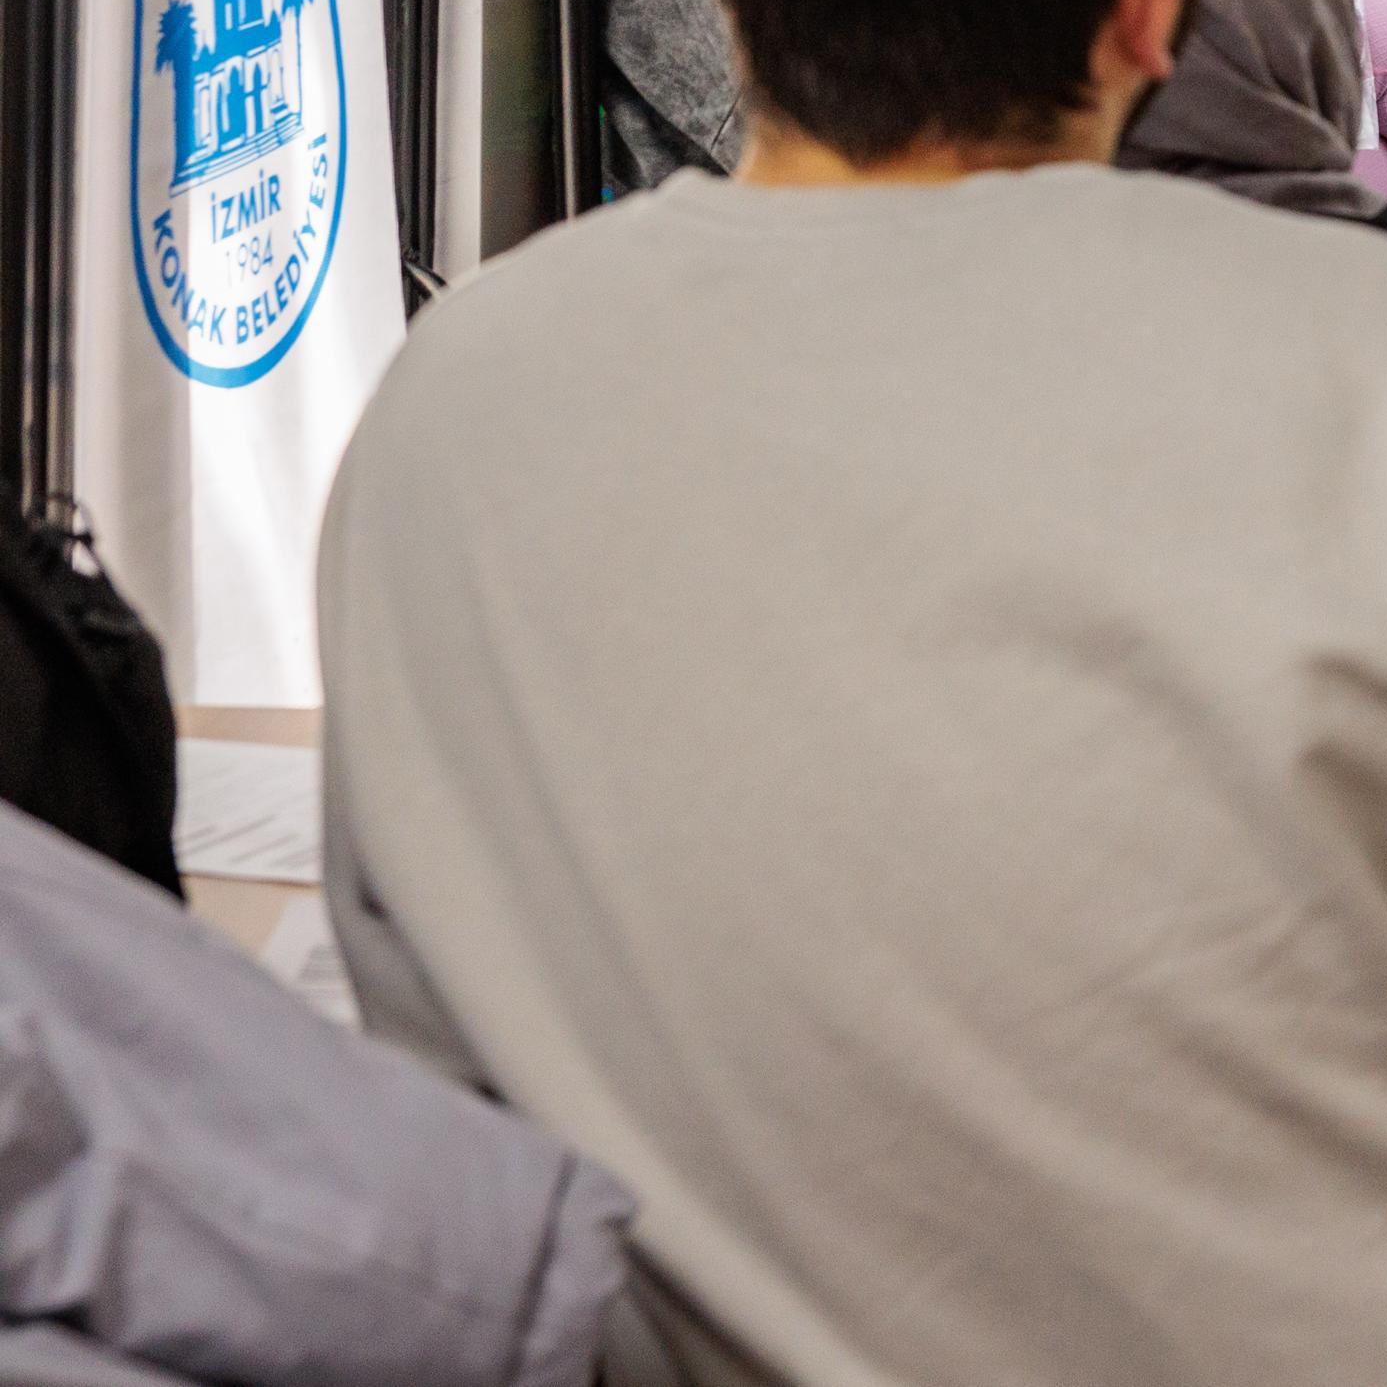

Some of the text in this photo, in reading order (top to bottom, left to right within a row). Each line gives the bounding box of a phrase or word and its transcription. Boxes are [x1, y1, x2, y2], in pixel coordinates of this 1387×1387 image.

[153, 132, 327, 345] KONAK BELEDİYESİ
[211, 169, 281, 243] İZMİR
[226, 229, 274, 287] 1984
